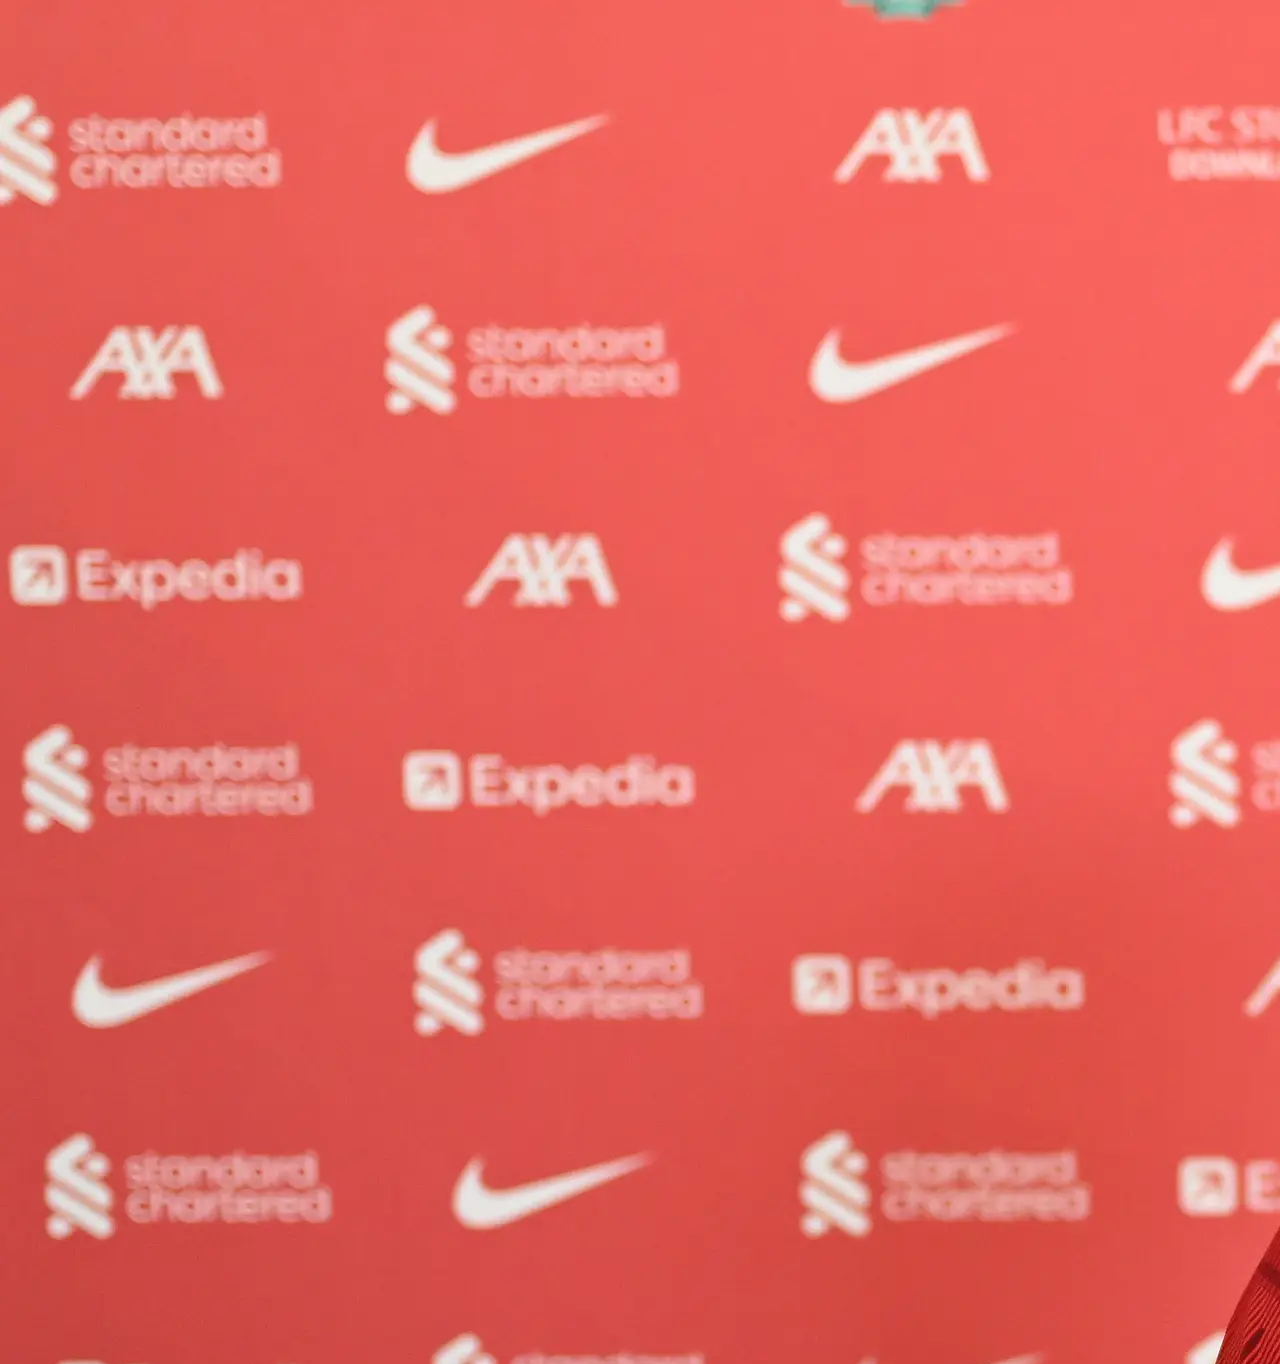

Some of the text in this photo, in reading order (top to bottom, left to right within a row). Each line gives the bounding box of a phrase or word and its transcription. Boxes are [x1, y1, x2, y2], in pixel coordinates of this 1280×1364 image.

[68, 112, 270, 152] standard
[1158, 106, 1222, 144] LFC
[835, 108, 989, 182] AXA
[70, 149, 282, 189] chartered
[467, 323, 668, 362] standard
[71, 326, 223, 399] AXA
[468, 359, 680, 397] chartered
[466, 534, 618, 606] AXA
[860, 532, 1061, 569] standard
[76, 548, 303, 610] Expedia
[861, 566, 1073, 605] chartered
[103, 742, 302, 781] standard
[857, 739, 1008, 812] AXA
[105, 778, 314, 816] chartered
[469, 754, 696, 815] Expedia
[494, 948, 692, 984] standard
[495, 981, 704, 1020] chartered
[858, 957, 1085, 1019] Expedia
[125, 1151, 321, 1188] standard
[881, 1150, 1079, 1186] standard
[125, 1185, 333, 1223] chartered
[881, 1183, 1091, 1221] chartered
